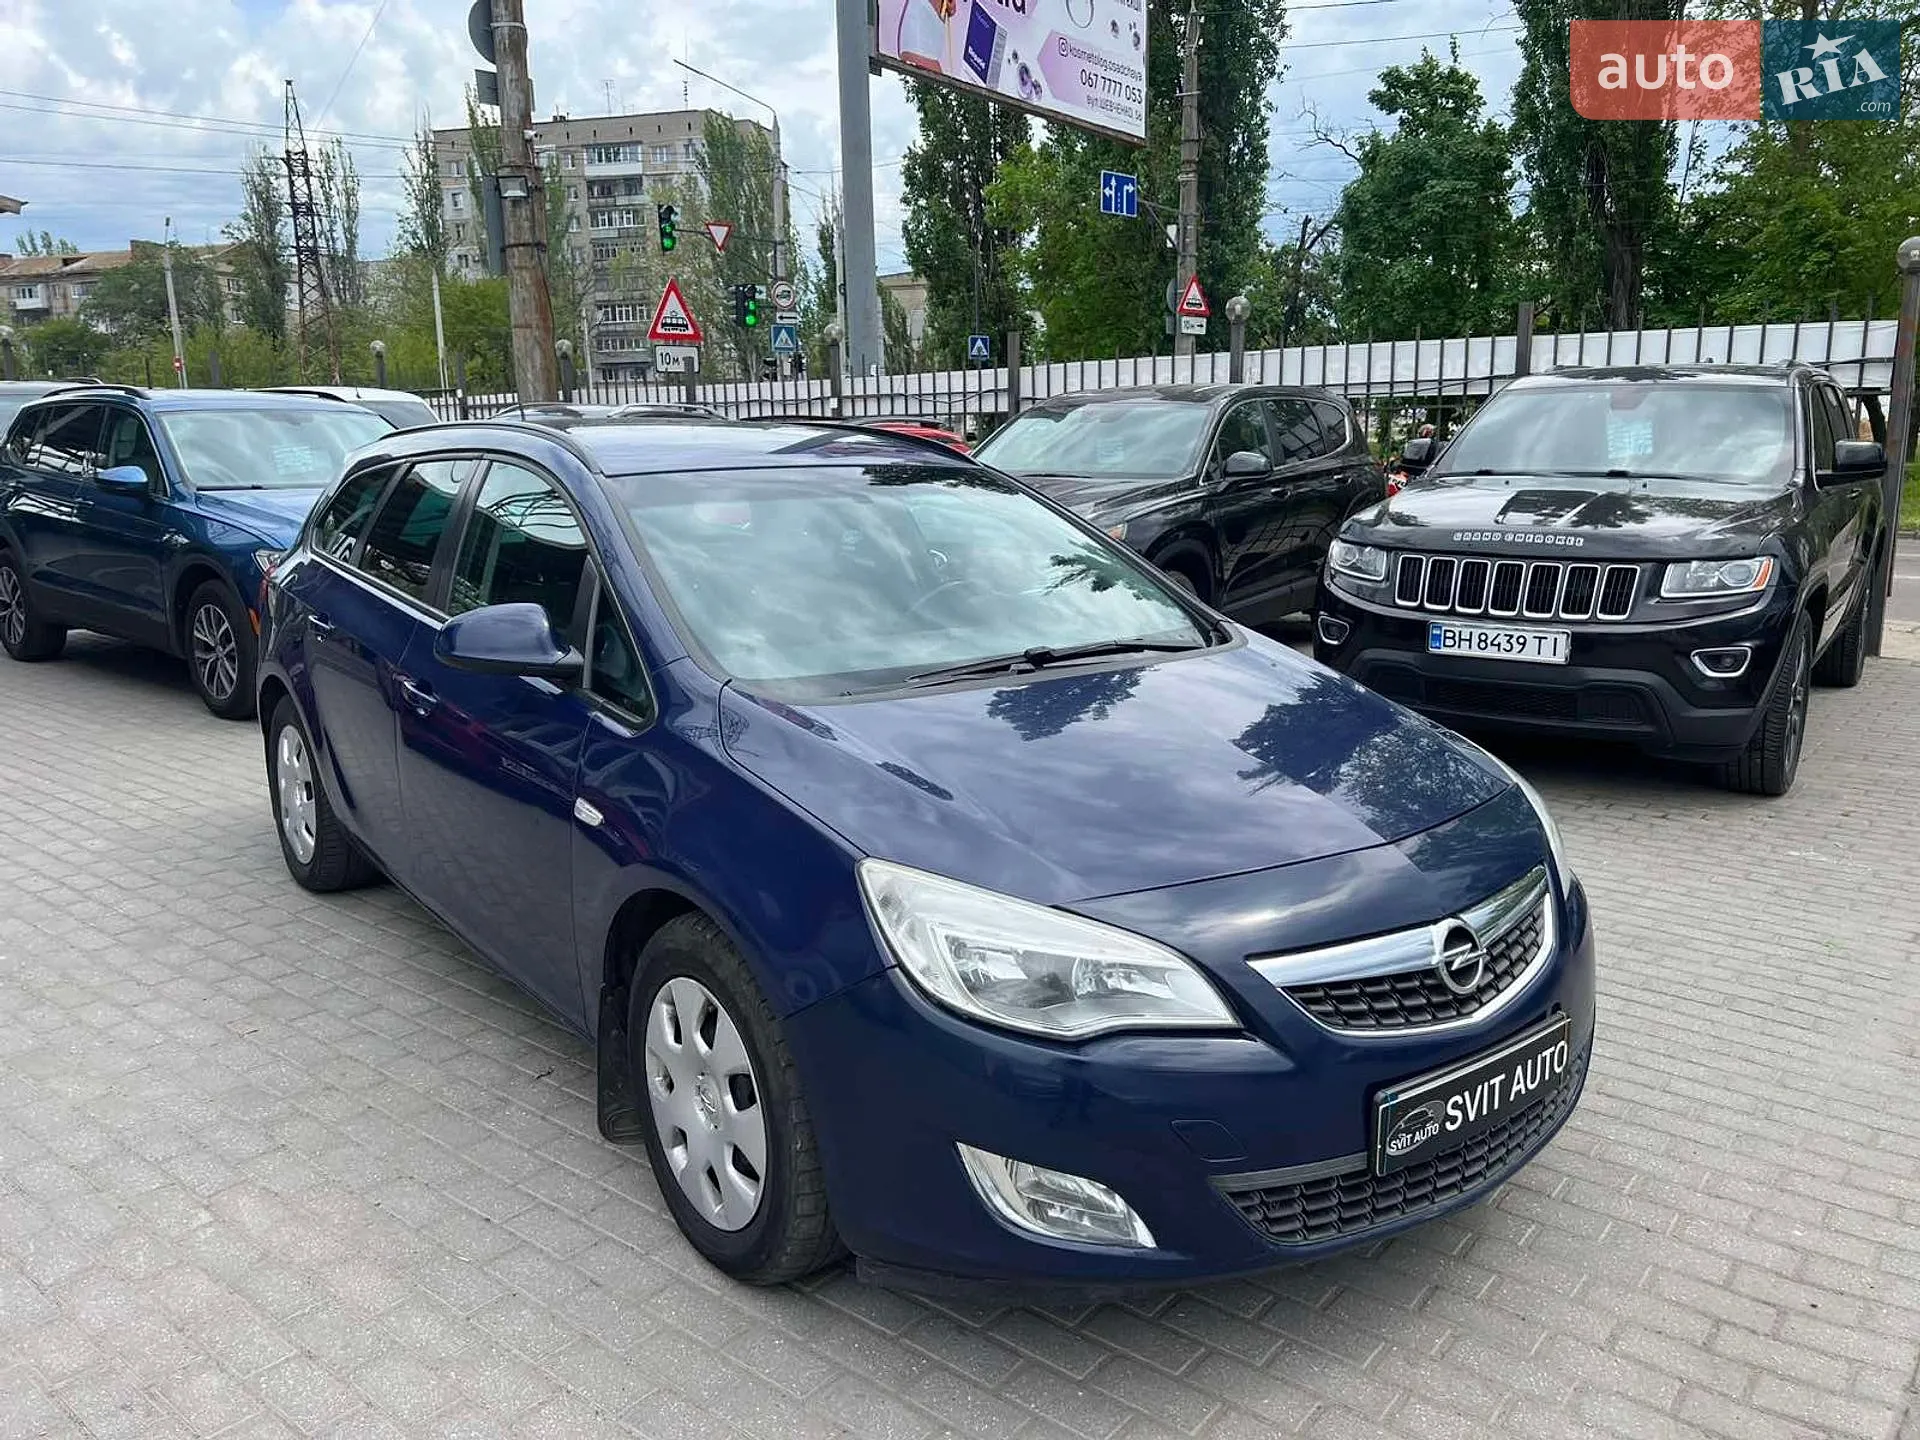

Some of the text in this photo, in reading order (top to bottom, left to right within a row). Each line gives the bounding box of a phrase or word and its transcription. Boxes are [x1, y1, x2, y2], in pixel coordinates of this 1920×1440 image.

[1080, 68, 1143, 105] 067 7777 053
[1443, 629, 1558, 657] BH 8439 TI
[1445, 1040, 1568, 1131] SVIT AUTO
[1390, 1123, 1439, 1152] SVIT AUTO
